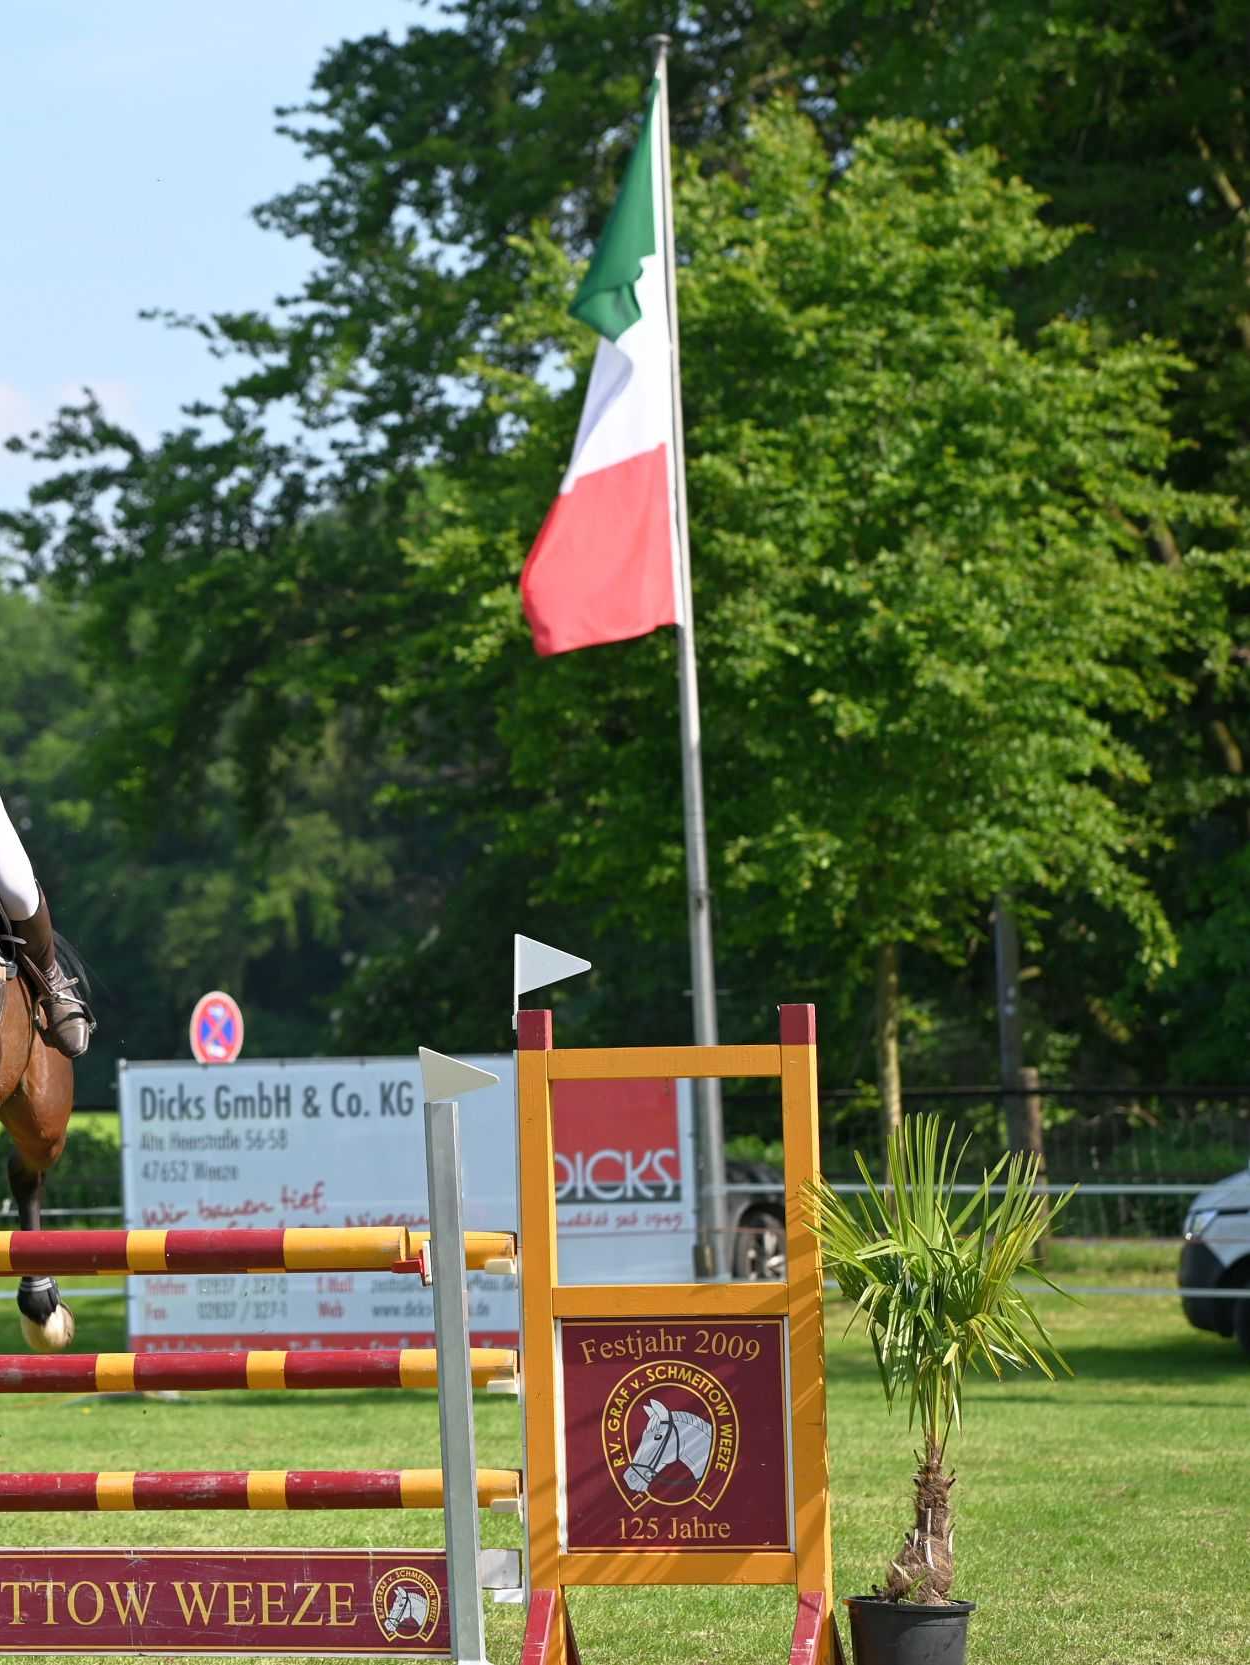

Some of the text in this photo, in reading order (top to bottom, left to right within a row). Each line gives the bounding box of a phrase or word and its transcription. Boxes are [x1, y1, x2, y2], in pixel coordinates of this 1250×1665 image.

[140, 1080, 414, 1121] Dicks GmbH & Co. KG
[579, 1328, 761, 1365] Festjahr 2009
[607, 1387, 631, 1432] GRAF
[630, 1379, 645, 1390] v.
[646, 1366, 730, 1417] SCHMETTOW
[715, 1423, 733, 1473] WEEZE
[619, 1516, 731, 1540] 125 Jahre
[171, 1582, 359, 1626] WEEZE
